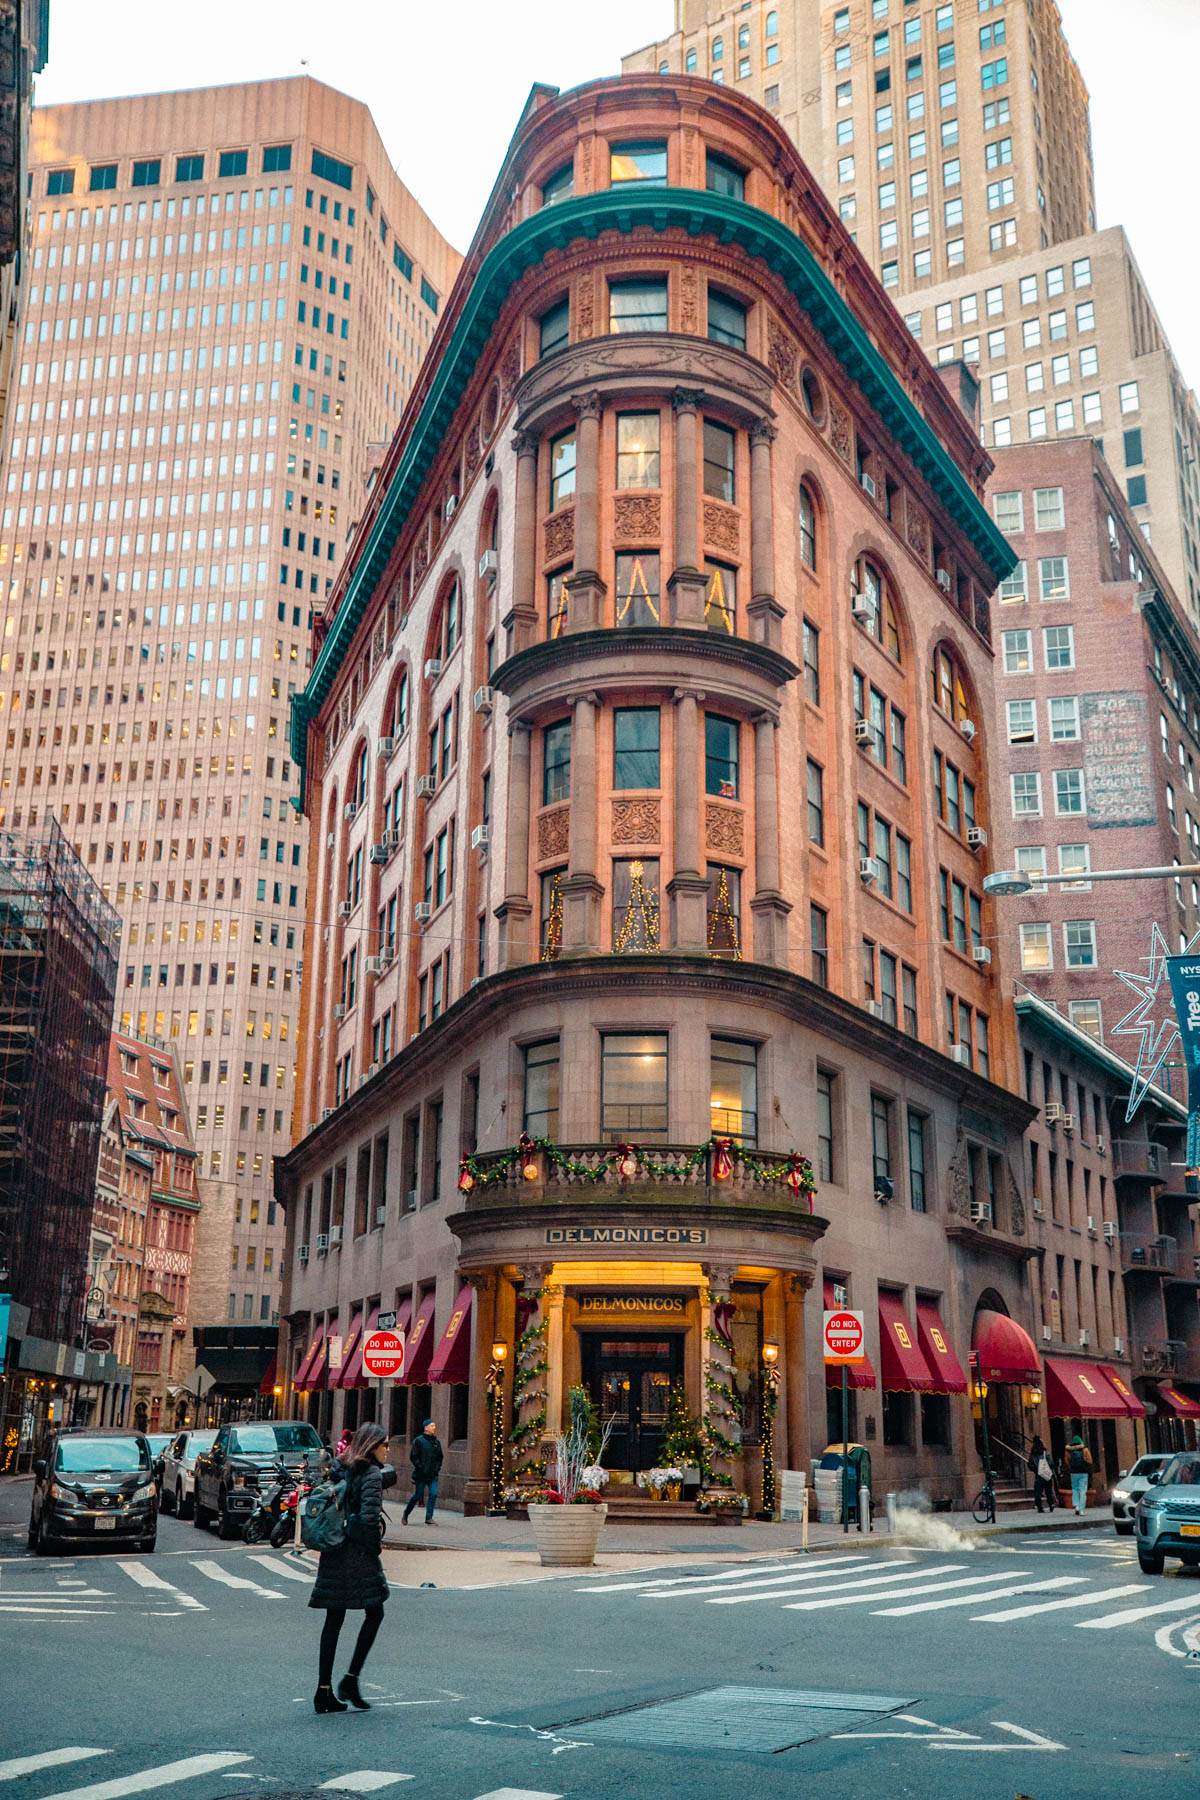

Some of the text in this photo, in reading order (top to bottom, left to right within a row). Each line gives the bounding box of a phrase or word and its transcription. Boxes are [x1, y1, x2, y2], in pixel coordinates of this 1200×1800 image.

[1186, 991, 1200, 1031] Tree
[550, 1229, 702, 1243] DELMONICO'S
[582, 1297, 683, 1312] DELMONICOS
[831, 1320, 856, 1328] DO NOT
[369, 1340, 398, 1348] DO NOT
[372, 1360, 395, 1368] ENTER
